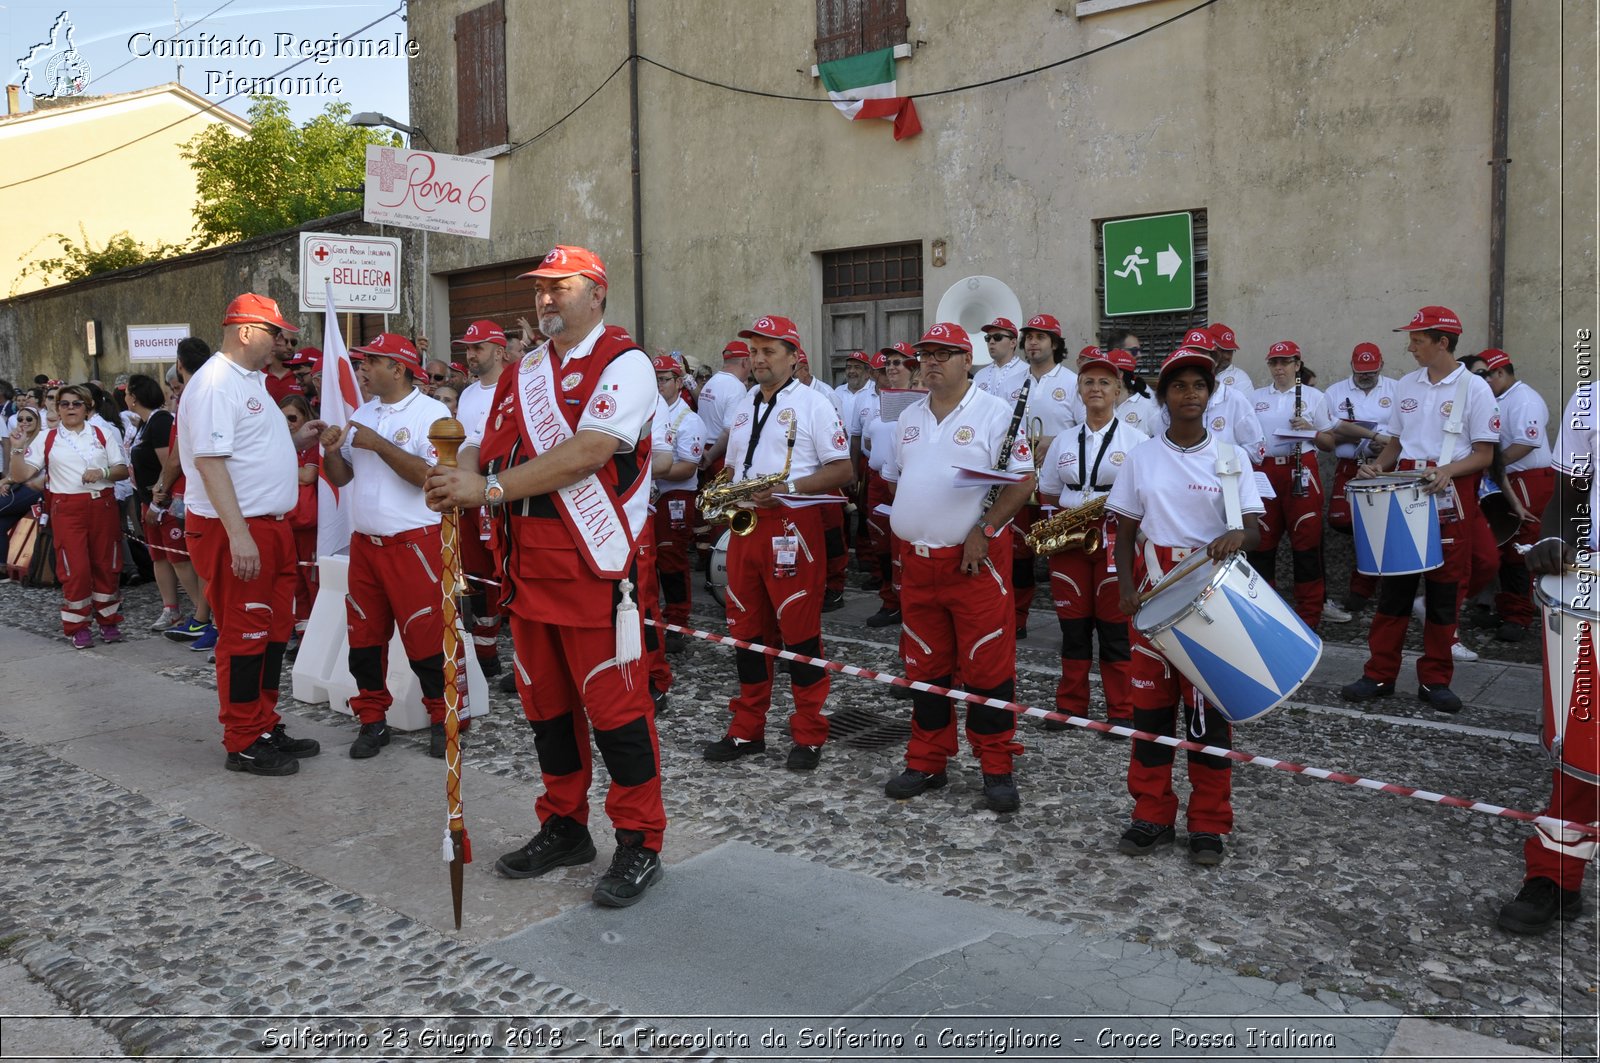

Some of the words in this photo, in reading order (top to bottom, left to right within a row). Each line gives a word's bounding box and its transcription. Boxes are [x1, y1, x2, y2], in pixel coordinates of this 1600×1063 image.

[467, 174, 490, 213] 6
[333, 267, 391, 287] BELLEGRA
[349, 294, 377, 302] LAZIO
[525, 374, 550, 422] CROCE
[534, 412, 566, 450] ROS
[568, 479, 616, 548] ALIANA
